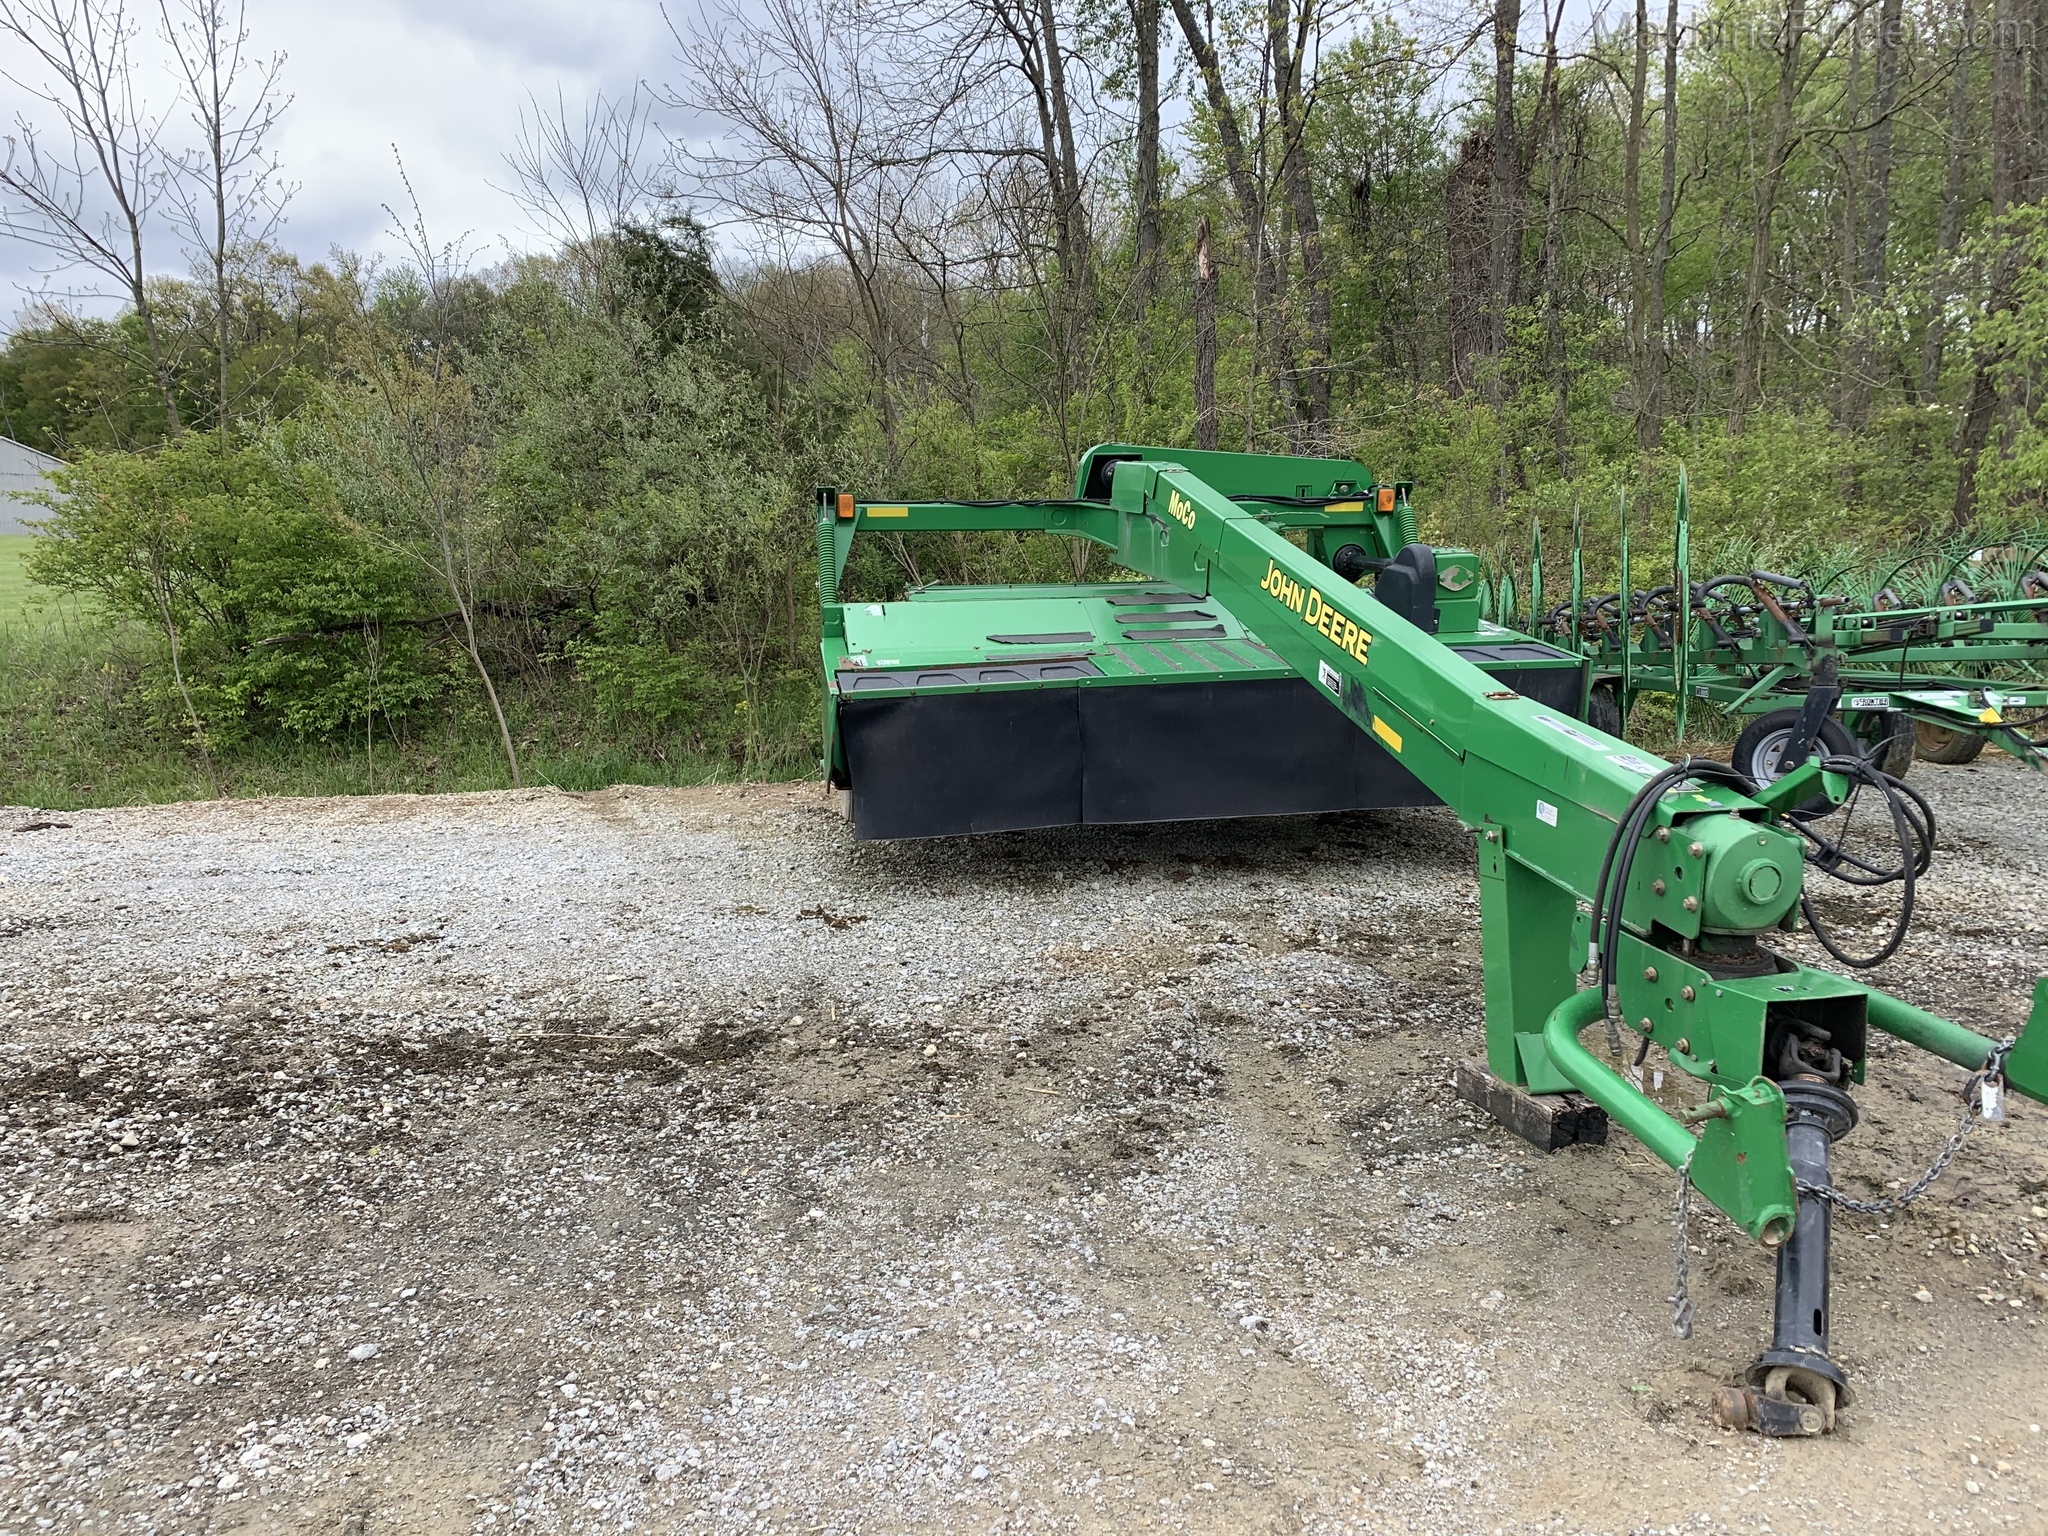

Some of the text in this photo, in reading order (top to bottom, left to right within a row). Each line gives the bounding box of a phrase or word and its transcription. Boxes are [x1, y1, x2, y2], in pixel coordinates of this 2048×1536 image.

[1167, 488, 1196, 531] MoCo
[1260, 557, 1373, 667] JOHN DEERE
